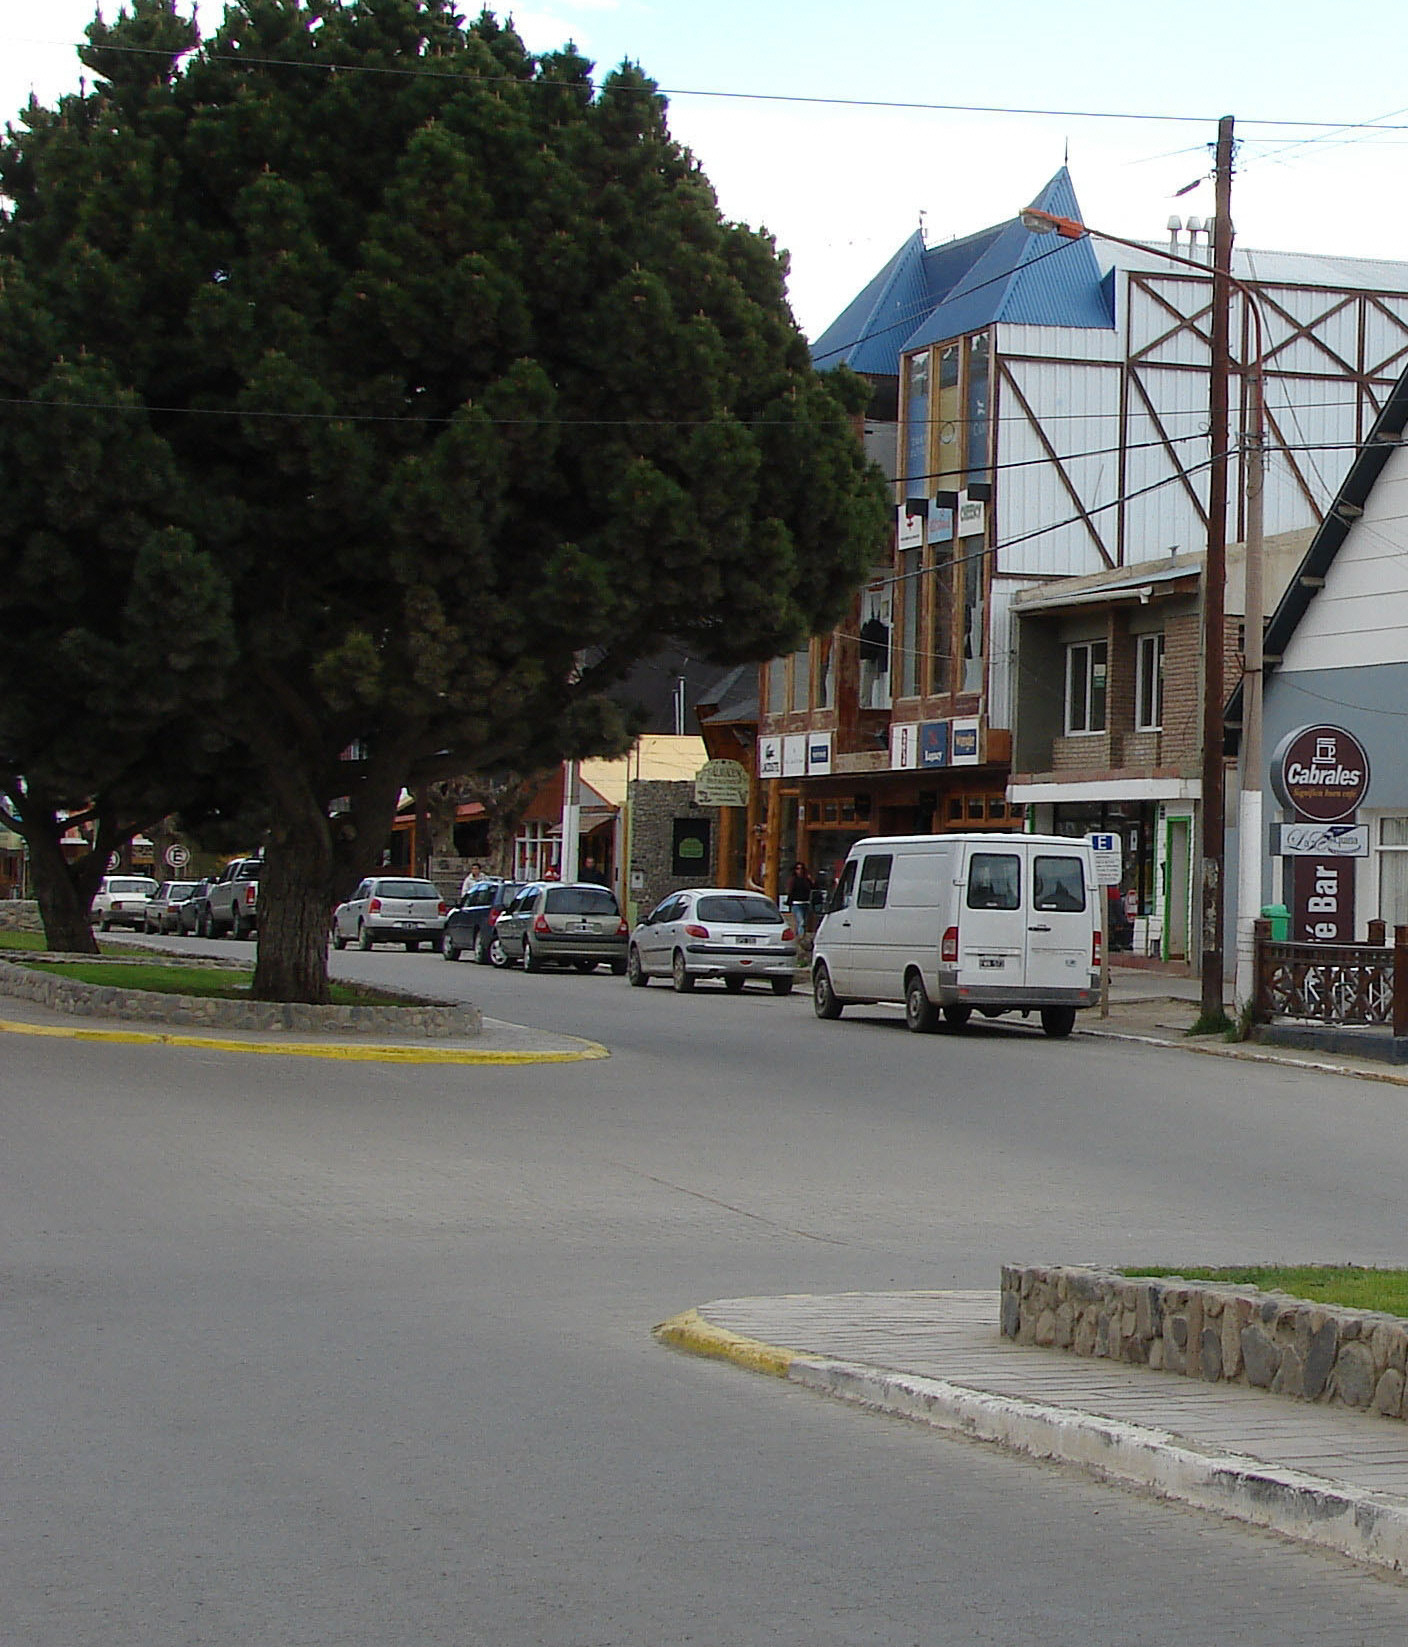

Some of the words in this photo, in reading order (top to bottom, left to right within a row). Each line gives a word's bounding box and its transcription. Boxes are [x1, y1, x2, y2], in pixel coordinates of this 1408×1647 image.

[1288, 763, 1362, 786] Cabrales
[1098, 836, 1108, 849] E
[1308, 866, 1338, 912] Bar
